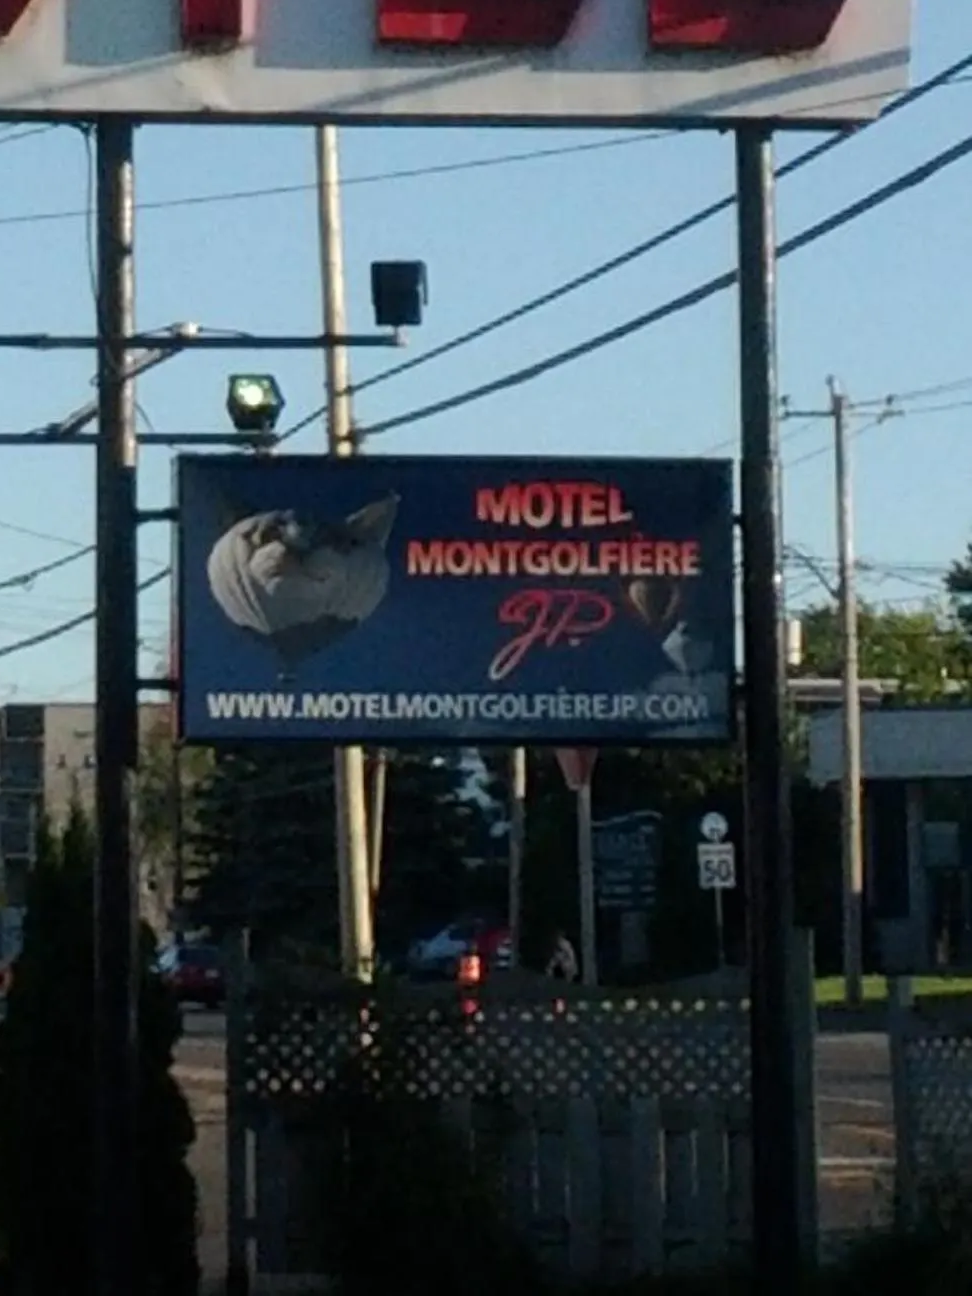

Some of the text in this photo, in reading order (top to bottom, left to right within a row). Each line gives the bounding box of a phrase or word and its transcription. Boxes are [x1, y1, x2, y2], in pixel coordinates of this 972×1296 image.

[475, 481, 634, 529] MOTEL
[406, 533, 703, 576] MONTGOLFIÈRE
[705, 858, 732, 884] 50
